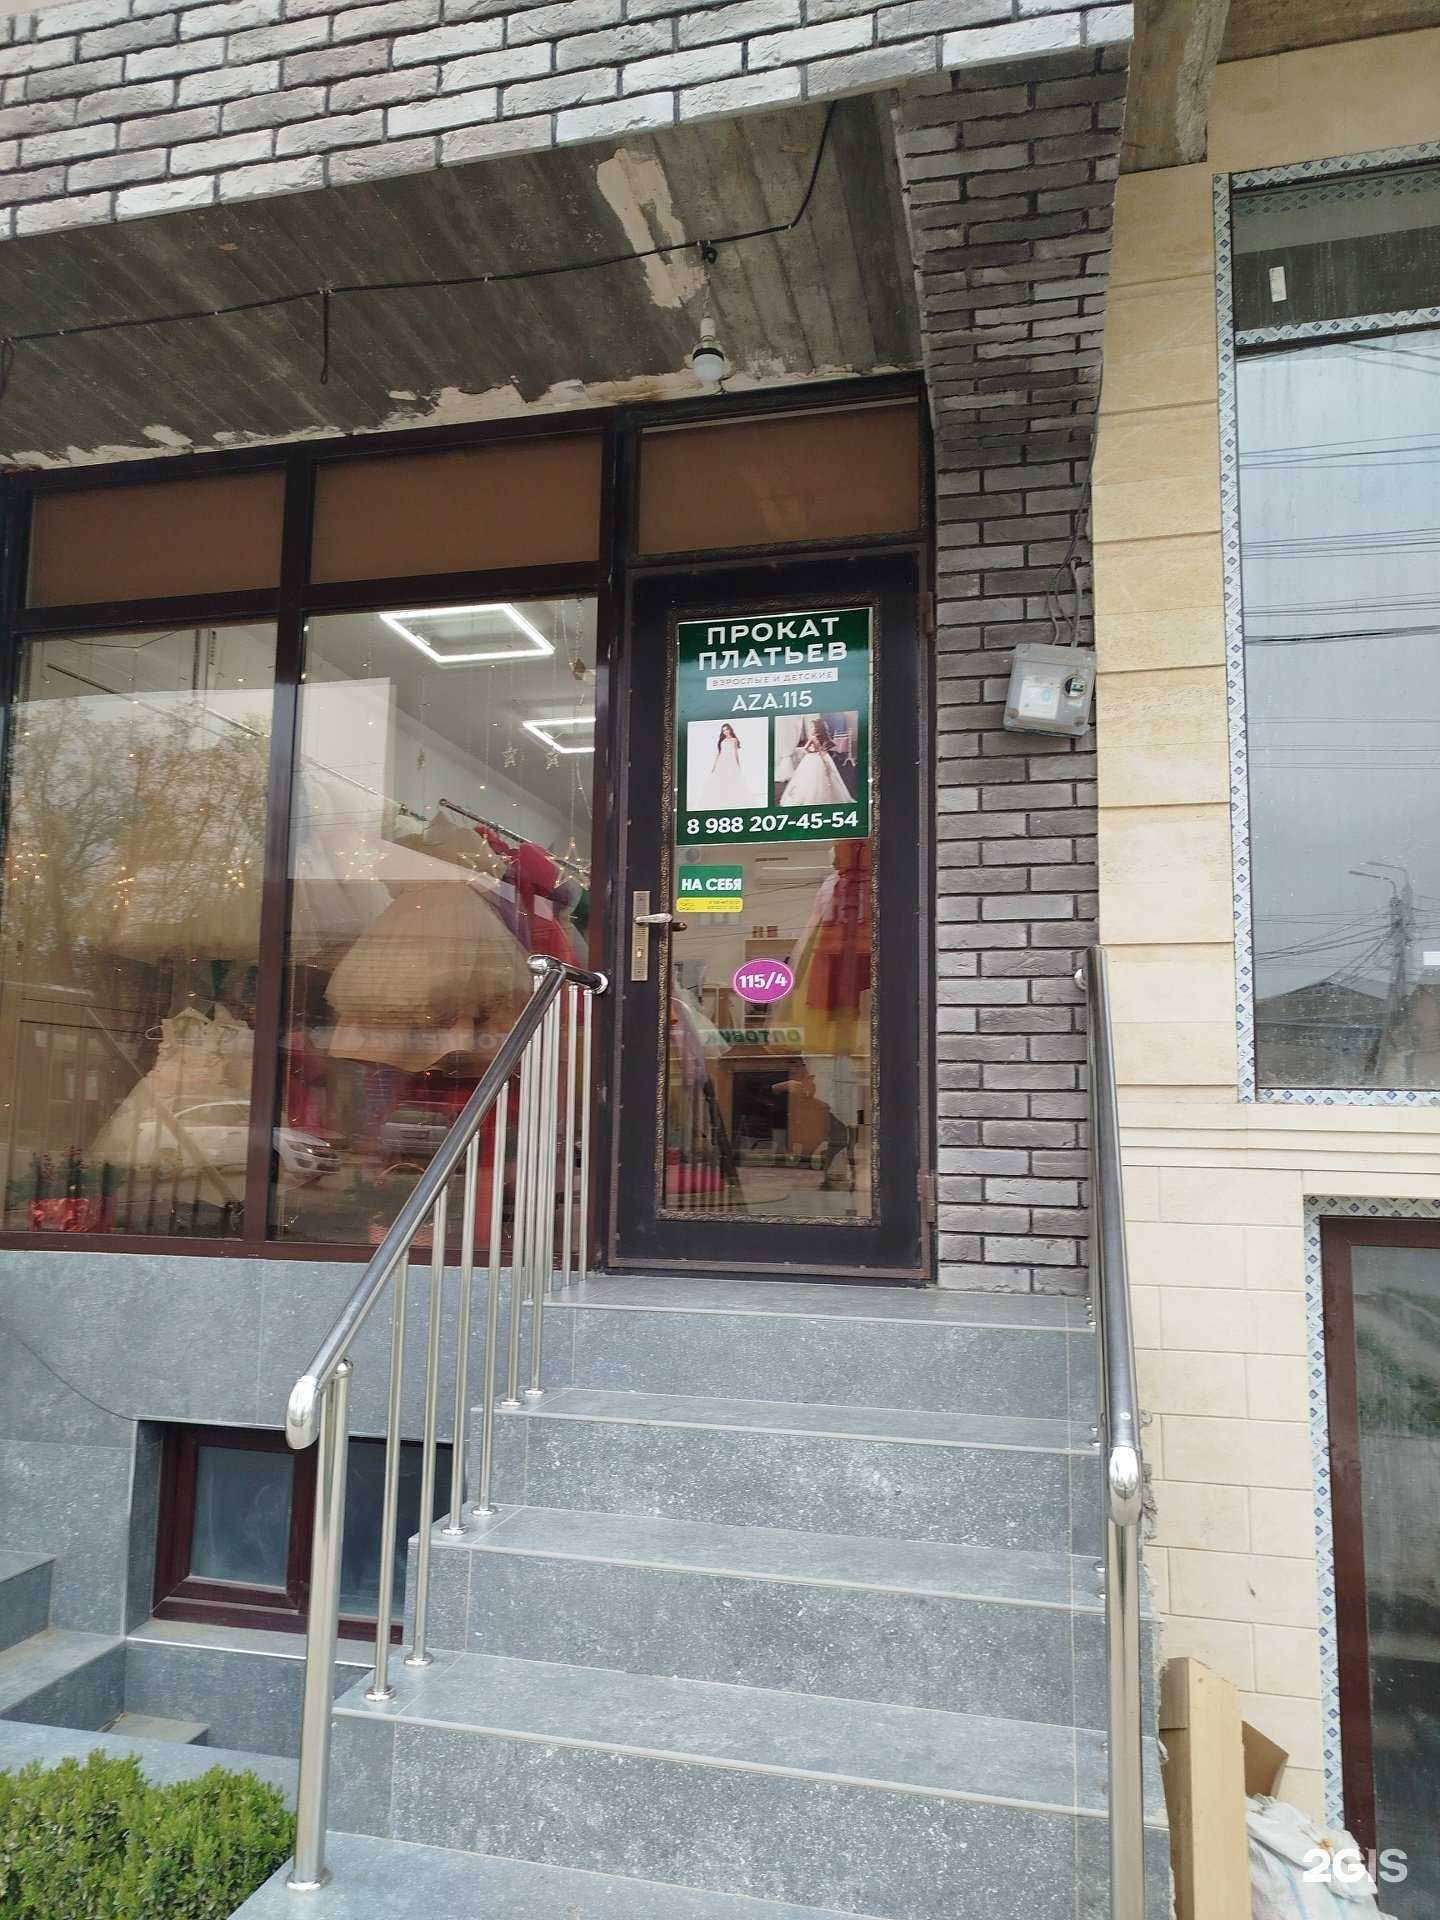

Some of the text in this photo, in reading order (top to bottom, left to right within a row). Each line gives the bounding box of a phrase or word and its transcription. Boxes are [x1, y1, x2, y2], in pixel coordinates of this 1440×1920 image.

[707, 617, 840, 645] ПРОКАТ
[699, 641, 848, 671] ПЛАТЬЕВ
[712, 676, 769, 687] ВЗРОСЛЫЕ
[783, 671, 833, 682] ДЕТСКИЕ
[731, 690, 813, 712] AZA.115
[686, 811, 858, 835] 8 988 207-45-54
[681, 878, 742, 891] НА СЕБЯ
[738, 971, 788, 990] 115/4
